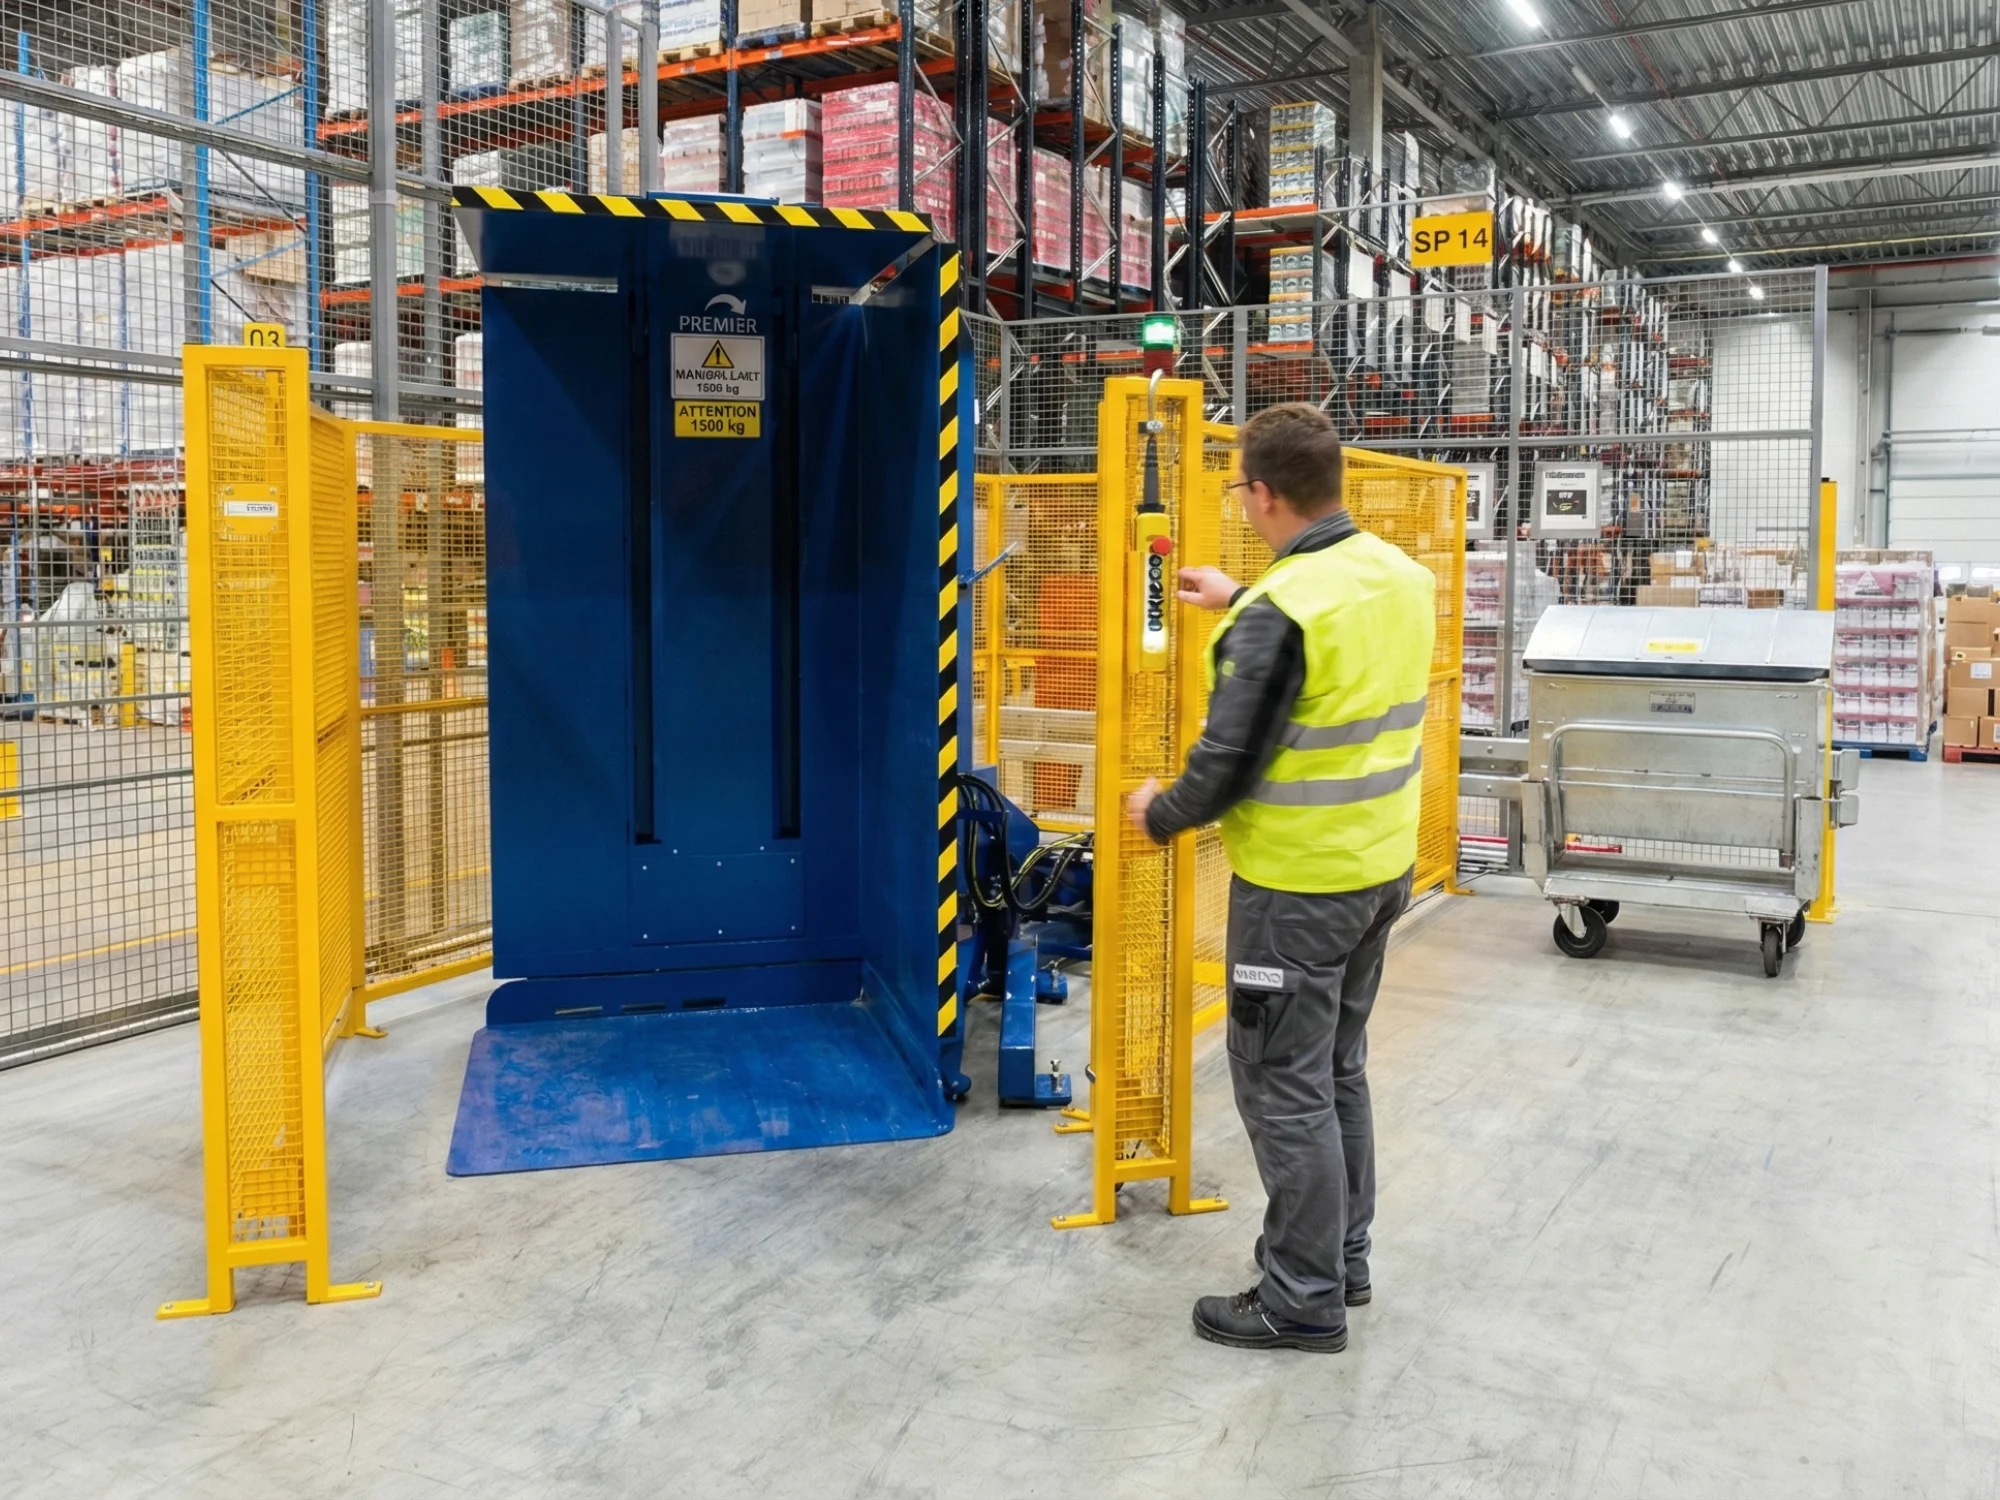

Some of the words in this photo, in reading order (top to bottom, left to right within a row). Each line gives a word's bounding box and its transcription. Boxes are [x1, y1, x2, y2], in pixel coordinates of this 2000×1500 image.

[1414, 229, 1450, 253] SP
[1458, 227, 1489, 249] 14
[679, 315, 757, 333] PREMIER
[679, 405, 757, 418] ATTENTION
[691, 419, 724, 432] 1500
[728, 419, 745, 435] kg
